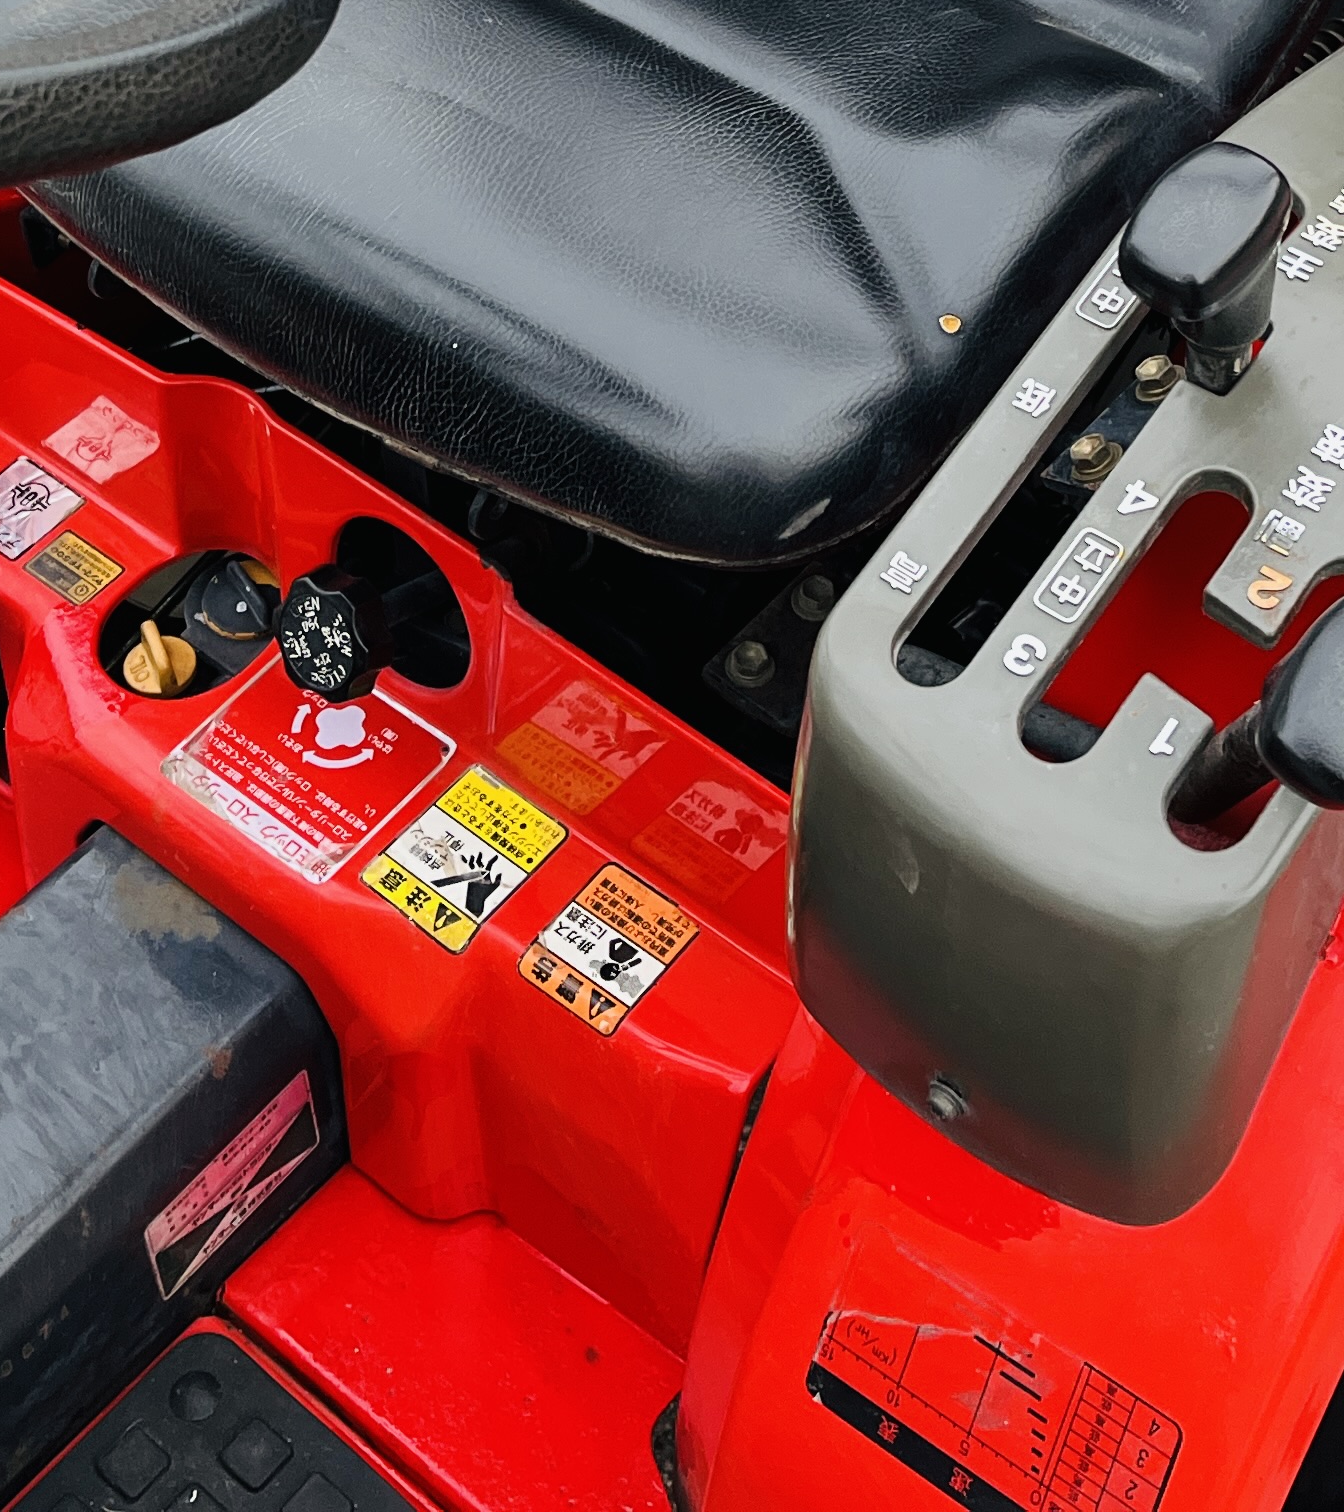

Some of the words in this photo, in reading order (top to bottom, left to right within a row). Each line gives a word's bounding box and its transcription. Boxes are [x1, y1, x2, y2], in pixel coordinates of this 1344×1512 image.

[1010, 377, 1058, 417] 低
[1115, 478, 1162, 519] 4
[878, 550, 930, 595] 高
[1047, 533, 1120, 606] 中立
[1245, 564, 1294, 610] 2
[1001, 632, 1048, 676] 3
[301, 686, 329, 709] ロック
[275, 731, 304, 753] おそい
[366, 732, 394, 754] はやい
[1147, 717, 1182, 757] 1
[438, 829, 465, 852] 停止
[376, 866, 432, 914] 注意
[551, 918, 596, 956] 排ガス
[564, 905, 607, 941] に注意
[526, 952, 587, 1004] 警告
[819, 1342, 836, 1362] 15
[886, 1389, 902, 1410] 10
[1147, 1418, 1161, 1438] 4
[957, 1438, 972, 1459] 5
[1135, 1448, 1150, 1470] 3
[1124, 1479, 1140, 1501] 2
